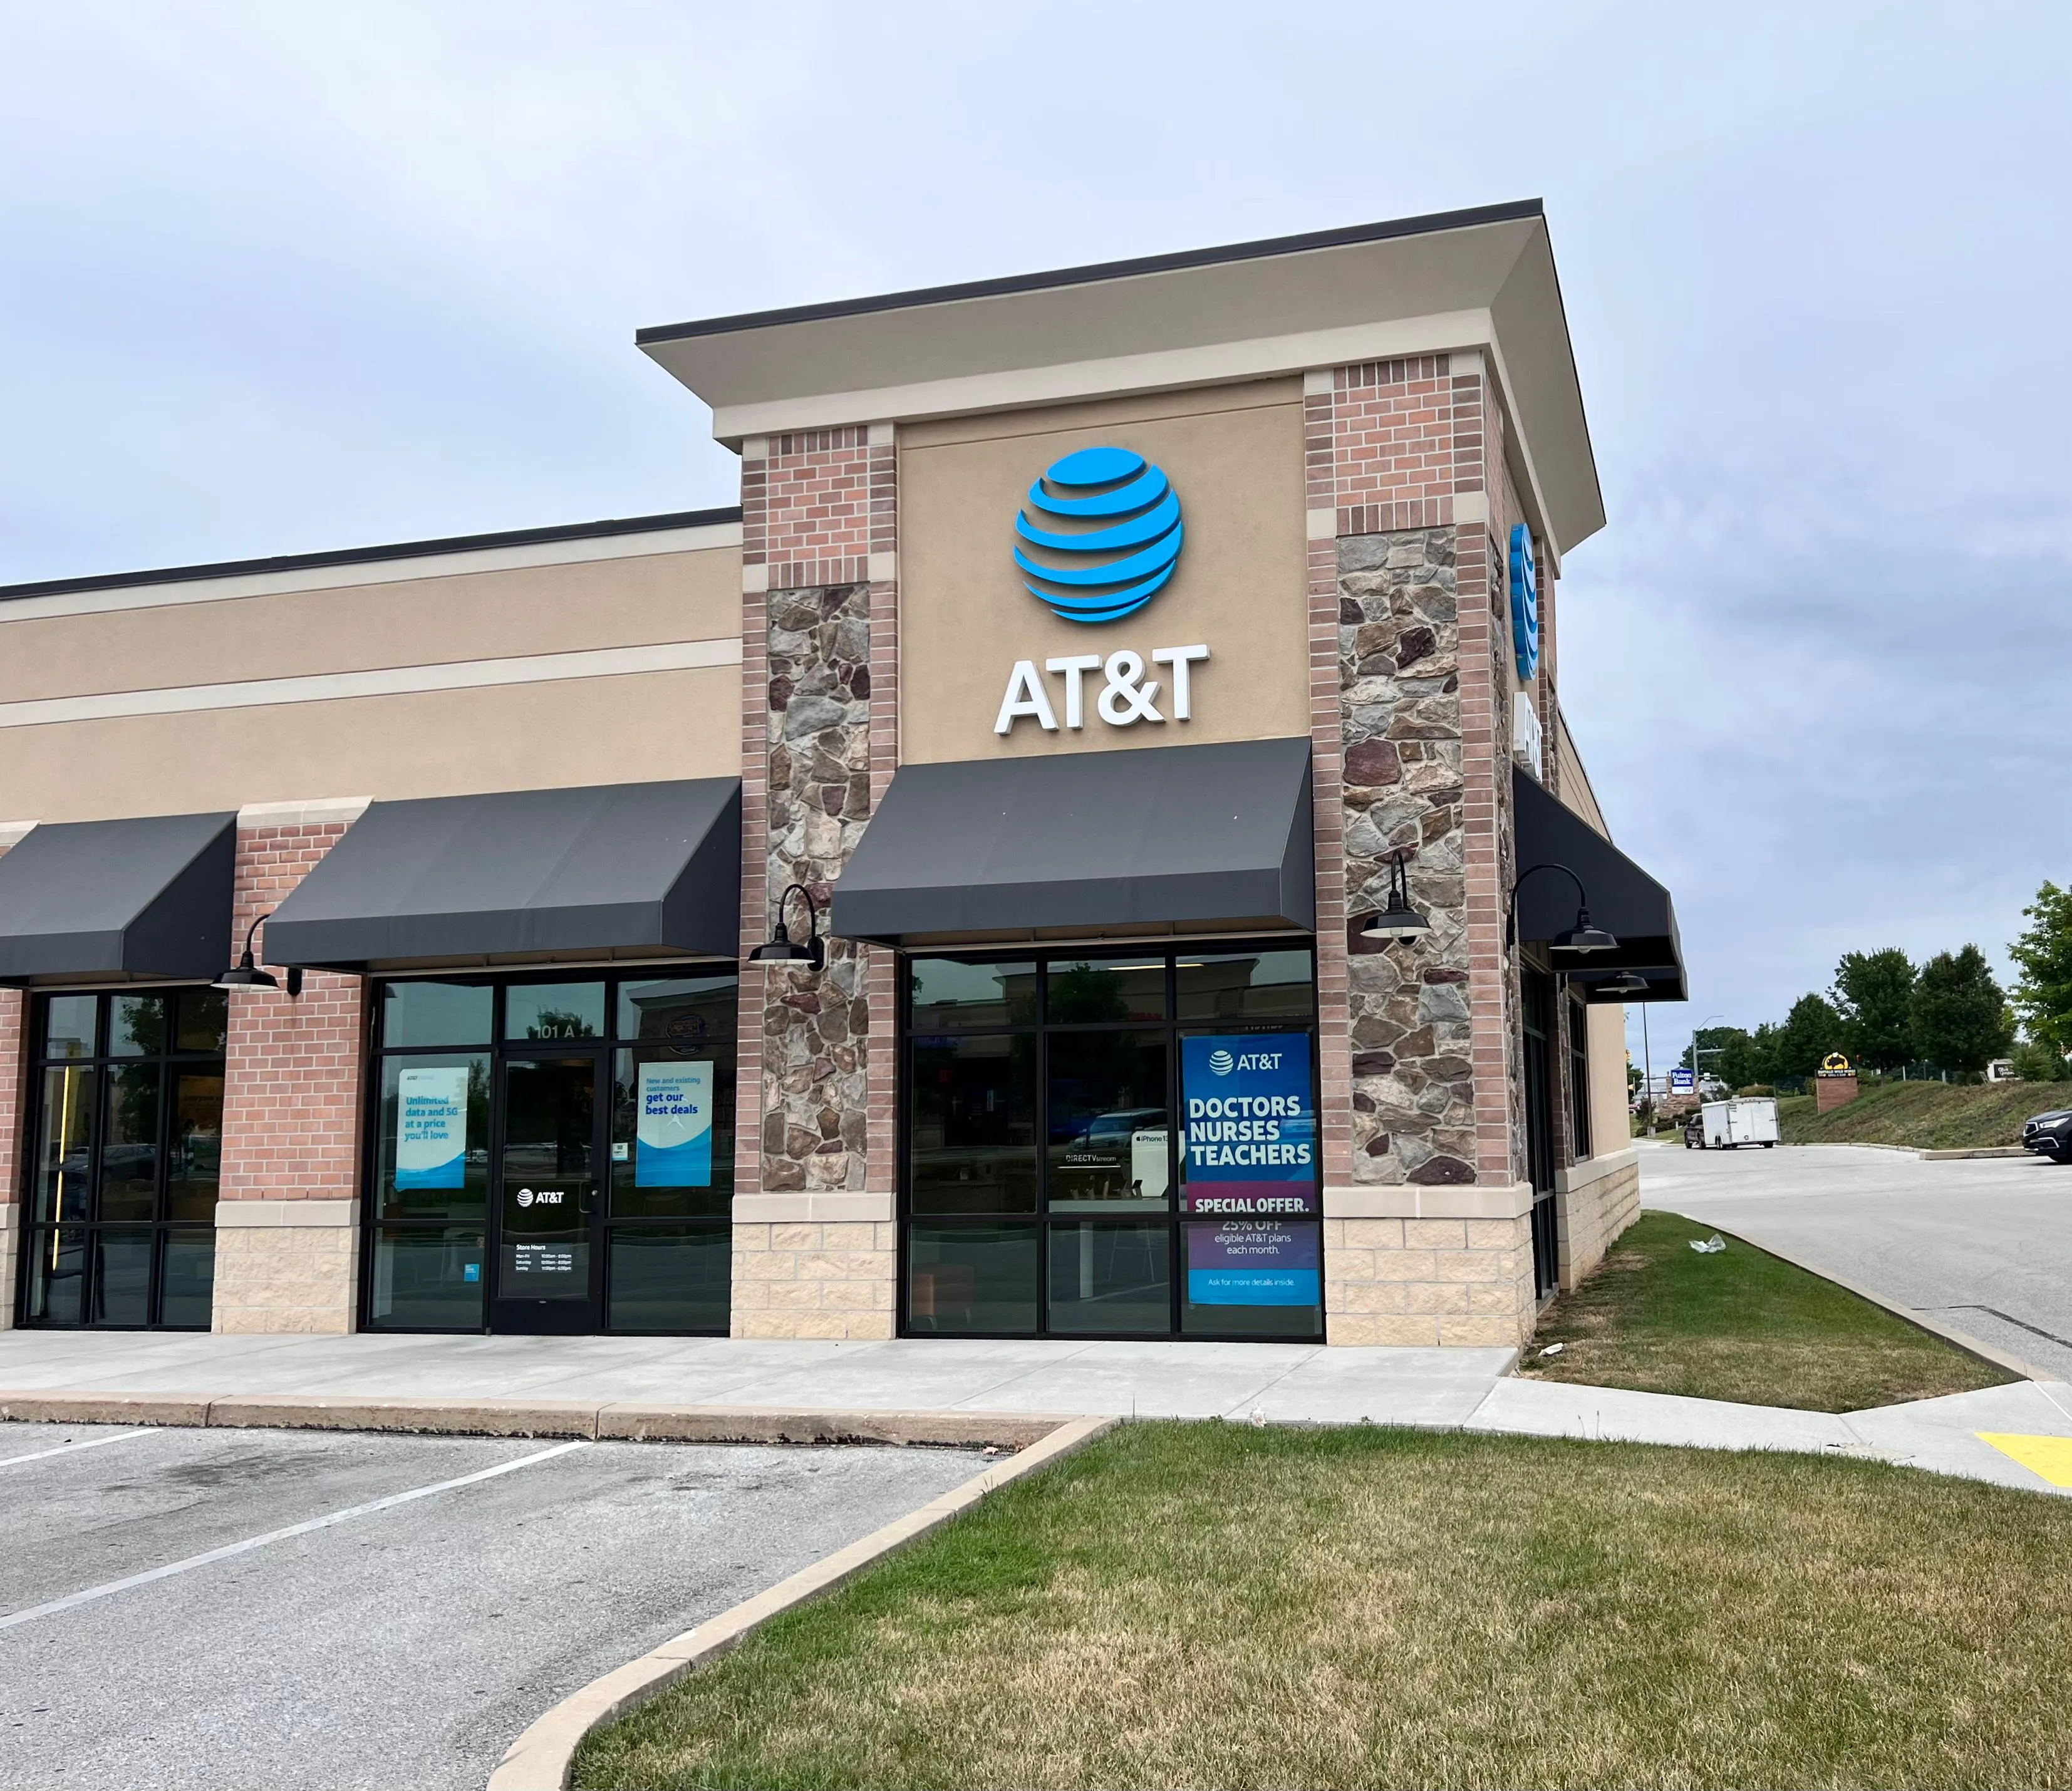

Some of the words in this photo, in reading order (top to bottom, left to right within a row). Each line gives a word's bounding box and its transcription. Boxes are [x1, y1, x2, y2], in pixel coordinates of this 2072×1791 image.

[994, 645, 1210, 735] AT&T
[536, 1025, 558, 1039] 101
[564, 1025, 575, 1037] A
[1237, 1053, 1282, 1070] AT&T
[406, 1096, 449, 1105] Unlimited
[646, 1093, 663, 1104] get
[406, 1108, 425, 1116] data
[427, 1107, 444, 1116] and
[446, 1107, 458, 1116] 5G
[646, 1105, 668, 1114] best
[671, 1104, 698, 1114] deals
[1190, 1096, 1300, 1119] DOCTORS
[405, 1120, 414, 1128] at
[424, 1118, 446, 1129] price
[404, 1130, 428, 1142] you'll
[430, 1130, 449, 1139] love
[1191, 1120, 1280, 1142] NURSES
[1191, 1143, 1311, 1166] TEACHERS
[536, 1191, 564, 1203] AT&T
[1195, 1198, 1255, 1212] SPECIAL
[1256, 1197, 1309, 1212] OFFER.
[1215, 1233, 1244, 1245] eligible
[1245, 1233, 1268, 1242] AT&T
[1269, 1233, 1291, 1244] plans
[1227, 1245, 1247, 1254] each
[1249, 1245, 1280, 1254] month.
